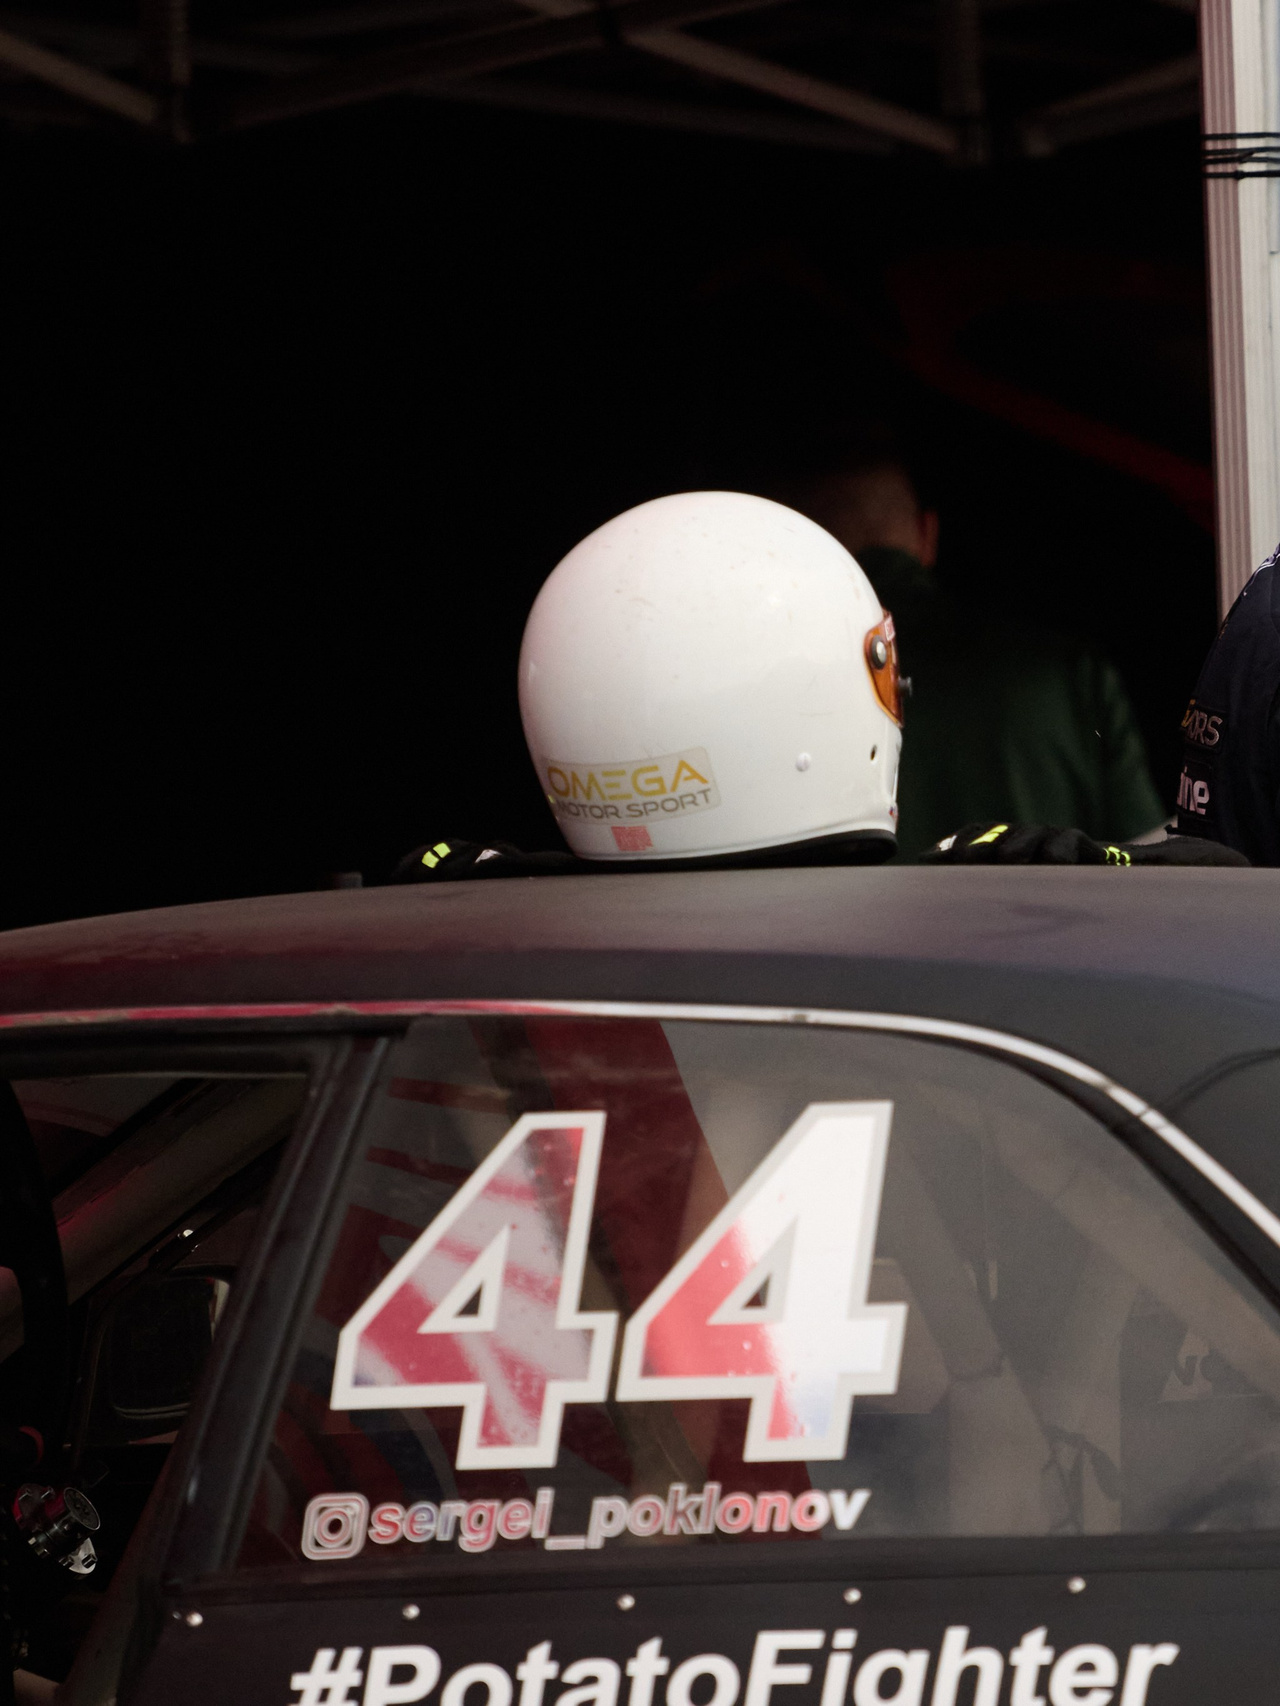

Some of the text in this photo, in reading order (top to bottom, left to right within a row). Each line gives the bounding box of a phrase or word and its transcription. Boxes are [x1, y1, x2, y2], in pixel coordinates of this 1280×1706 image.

[547, 759, 709, 801] OMEGA
[626, 788, 712, 818] SPORT
[330, 1101, 908, 1471] 44
[289, 1625, 1181, 1706] #PotatoFighter
